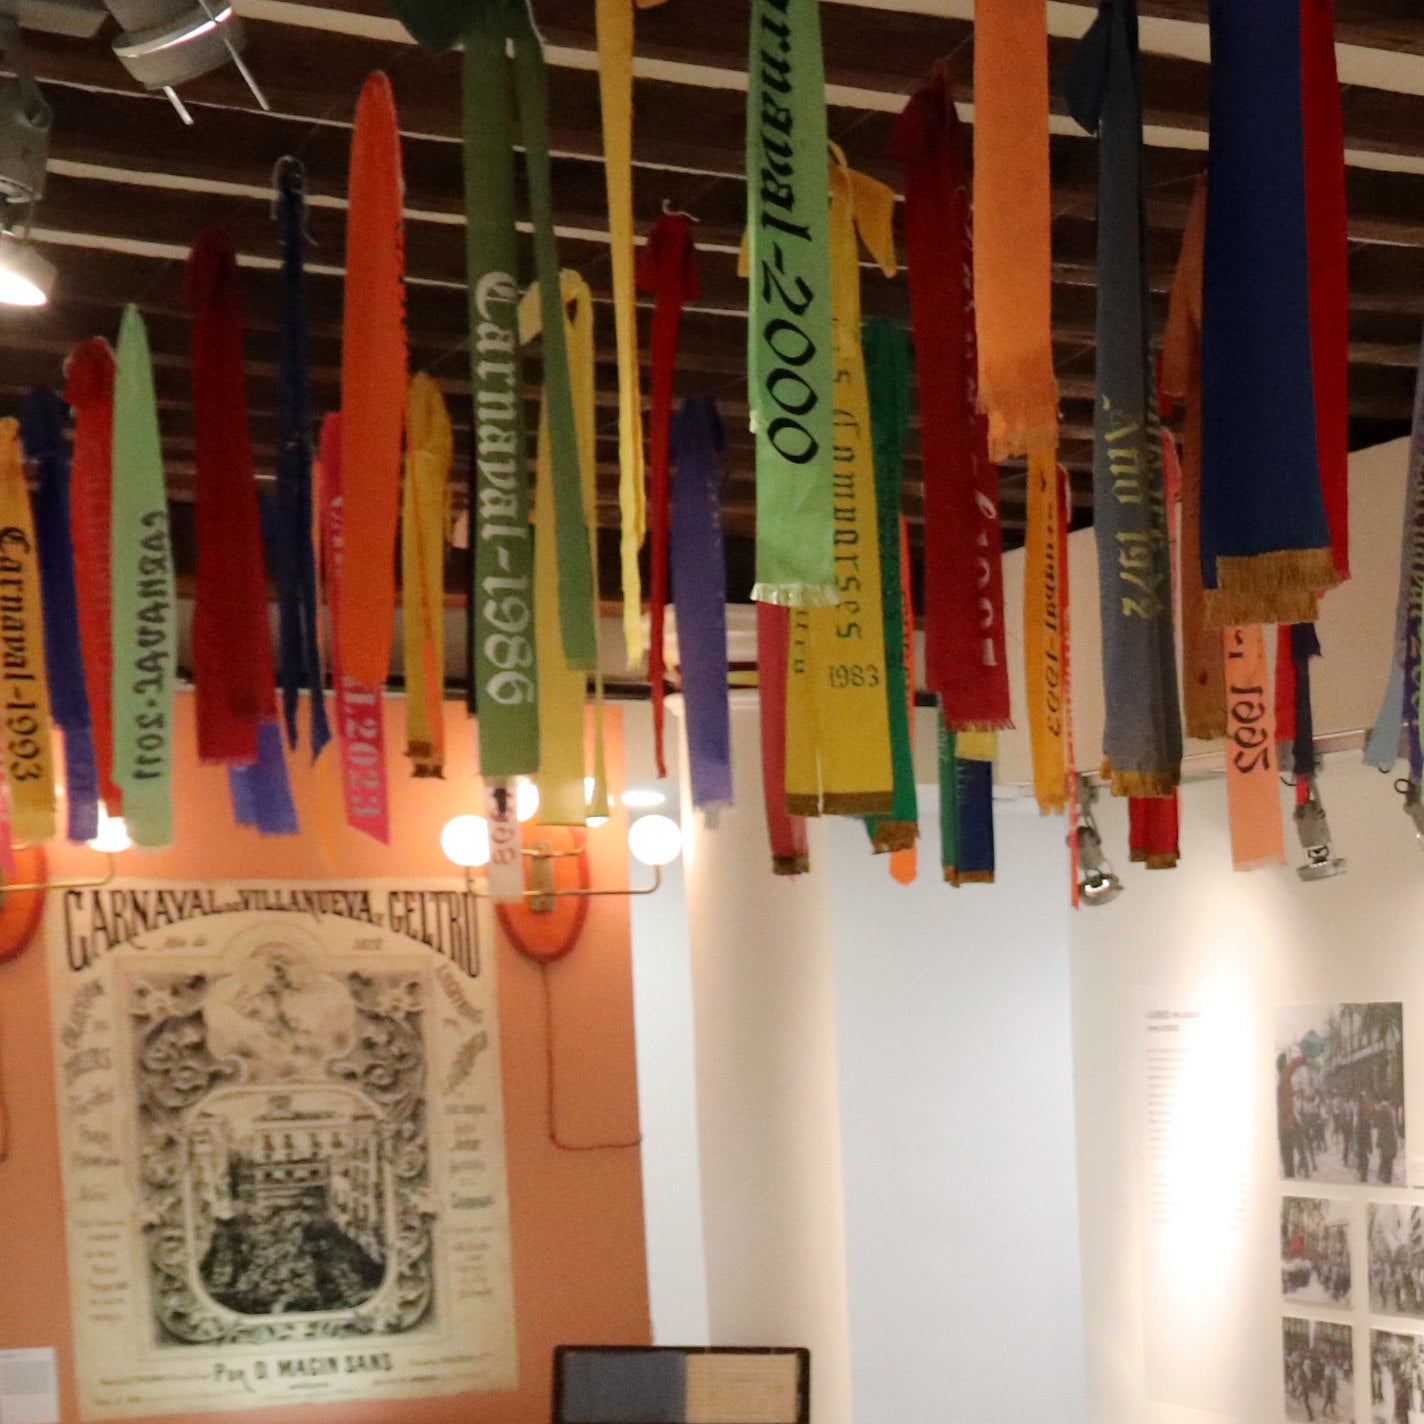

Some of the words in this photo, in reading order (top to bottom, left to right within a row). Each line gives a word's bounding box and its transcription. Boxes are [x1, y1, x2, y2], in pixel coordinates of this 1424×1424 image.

[761, 0, 819, 465] rnaval-2000
[0, 526, 42, 783] Carnaval-1993
[475, 271, 537, 705] Carnaval-1986
[64, 888, 220, 972] CARNAVAL
[238, 889, 374, 923] VILLANUEVA
